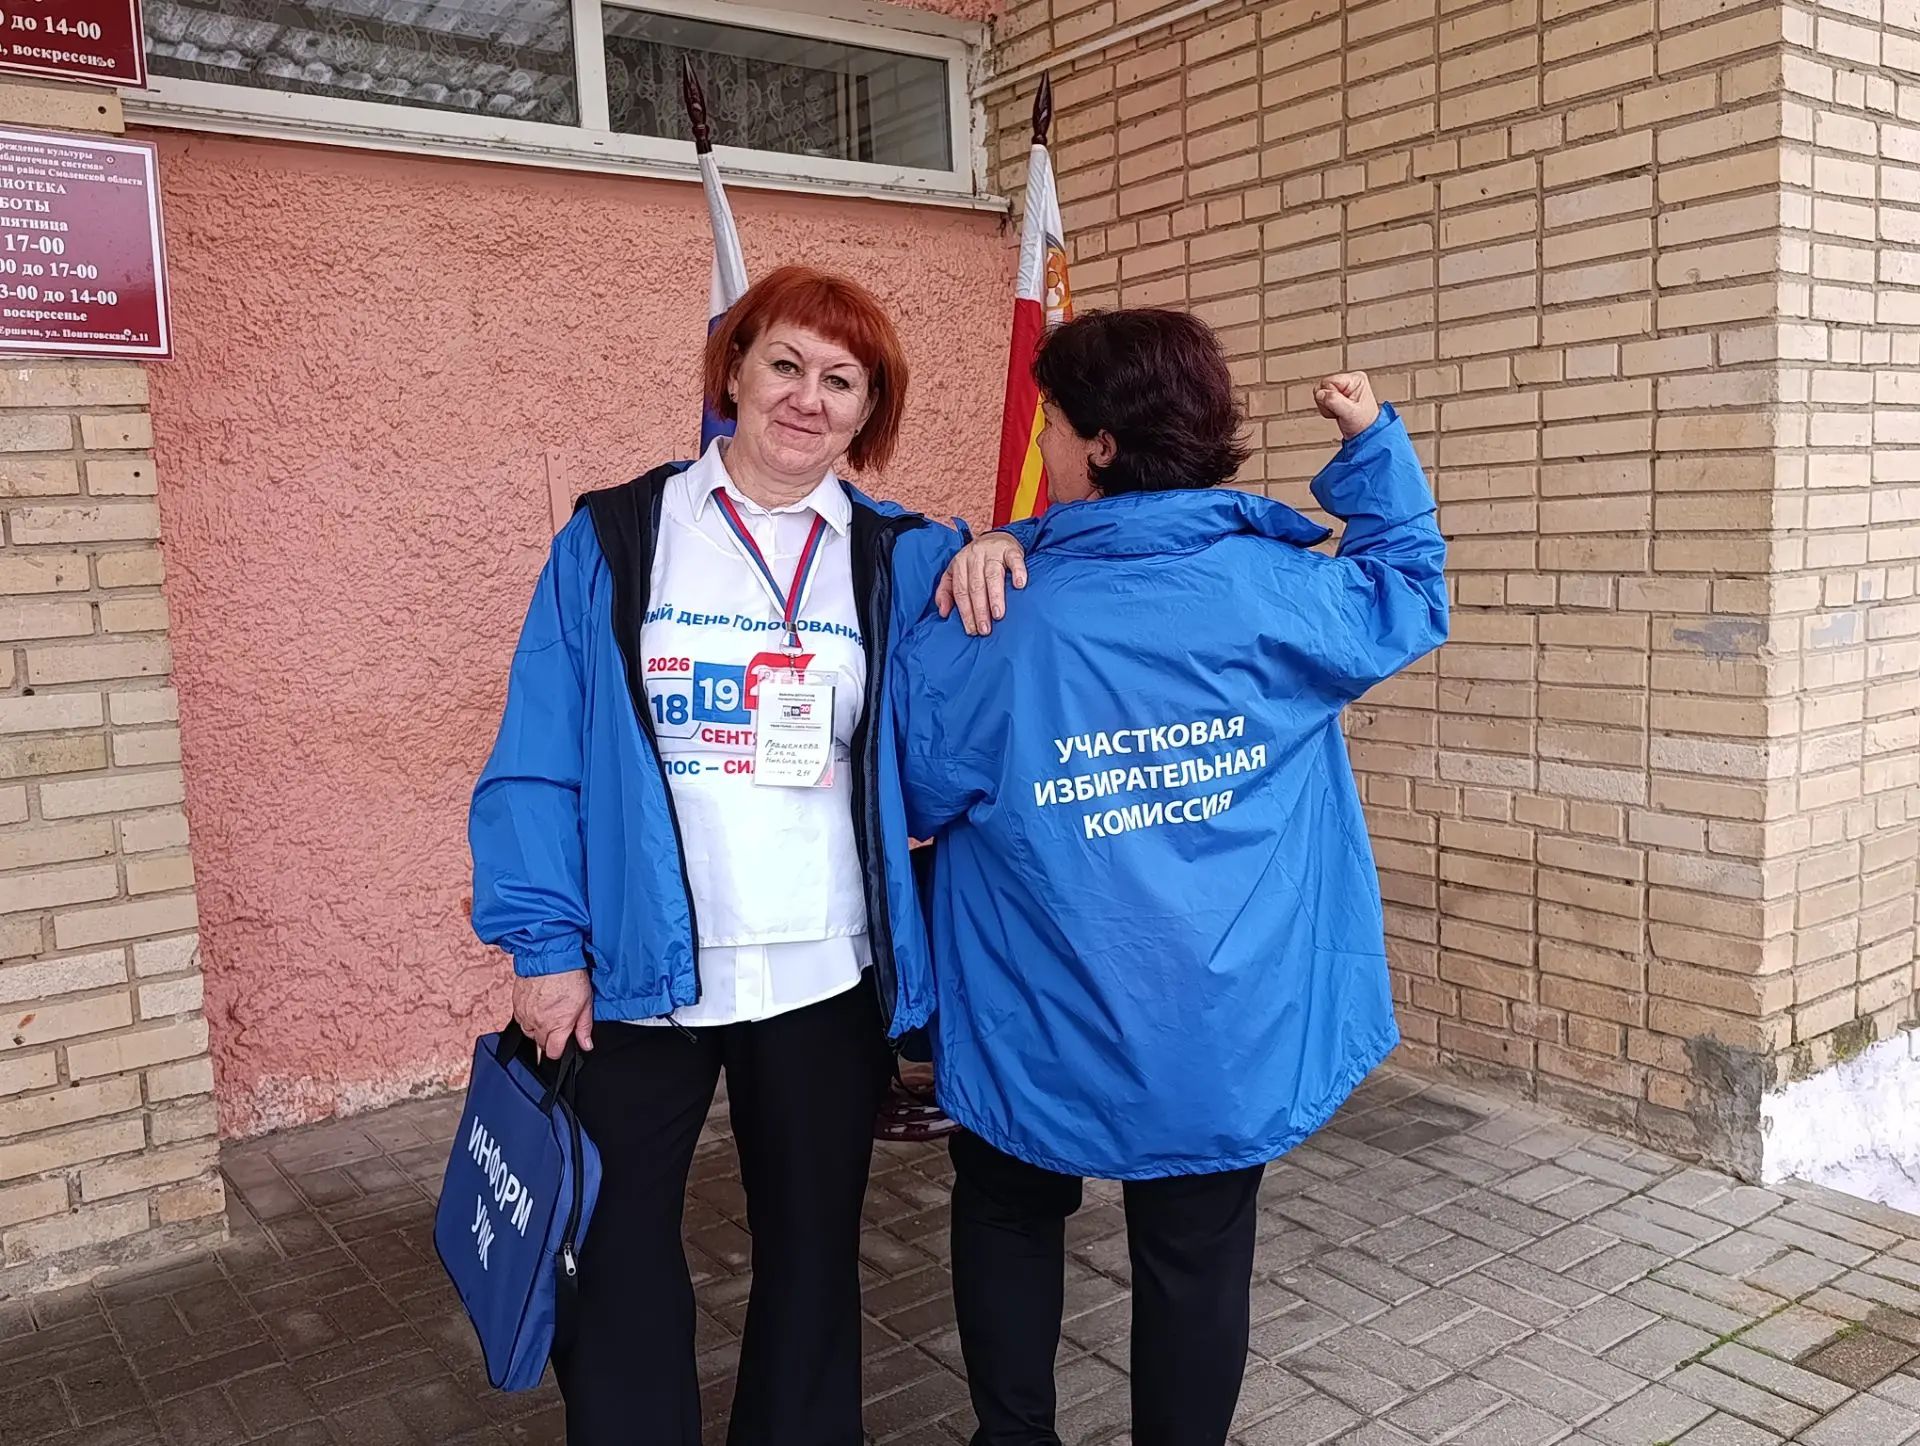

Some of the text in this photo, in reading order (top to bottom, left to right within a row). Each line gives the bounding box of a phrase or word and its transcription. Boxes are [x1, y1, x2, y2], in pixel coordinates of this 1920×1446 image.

[11, 15, 37, 31] до
[44, 16, 101, 40] 14-00
[13, 44, 116, 68] воскресенье
[47, 148, 93, 160] культуры
[16, 166, 46, 176] район
[48, 168, 106, 183] Смоленской
[107, 175, 143, 186] области
[0, 196, 50, 213] БОТЫ
[1, 216, 69, 232] пятница
[4, 234, 65, 255] 17-00
[22, 263, 44, 276] до
[50, 262, 98, 280] 17-00
[43, 290, 65, 304] до
[70, 288, 118, 306] 14-00
[3, 308, 88, 322] воскресенье
[45, 329, 60, 339] ул.
[676, 610, 730, 626] ДЕНЬ
[647, 657, 690, 673] 2026
[699, 677, 740, 712] 19
[651, 693, 689, 726] 18
[1053, 715, 1245, 764] УЧАСТКОВАЯ
[724, 760, 755, 775] СИ
[1033, 744, 1267, 807] ИЗБИРАТЕЛЬНАЯ
[1082, 790, 1234, 840] КОМИССИЯ
[467, 1115, 534, 1238] ИНФОРМ
[471, 1194, 495, 1272] УИК
